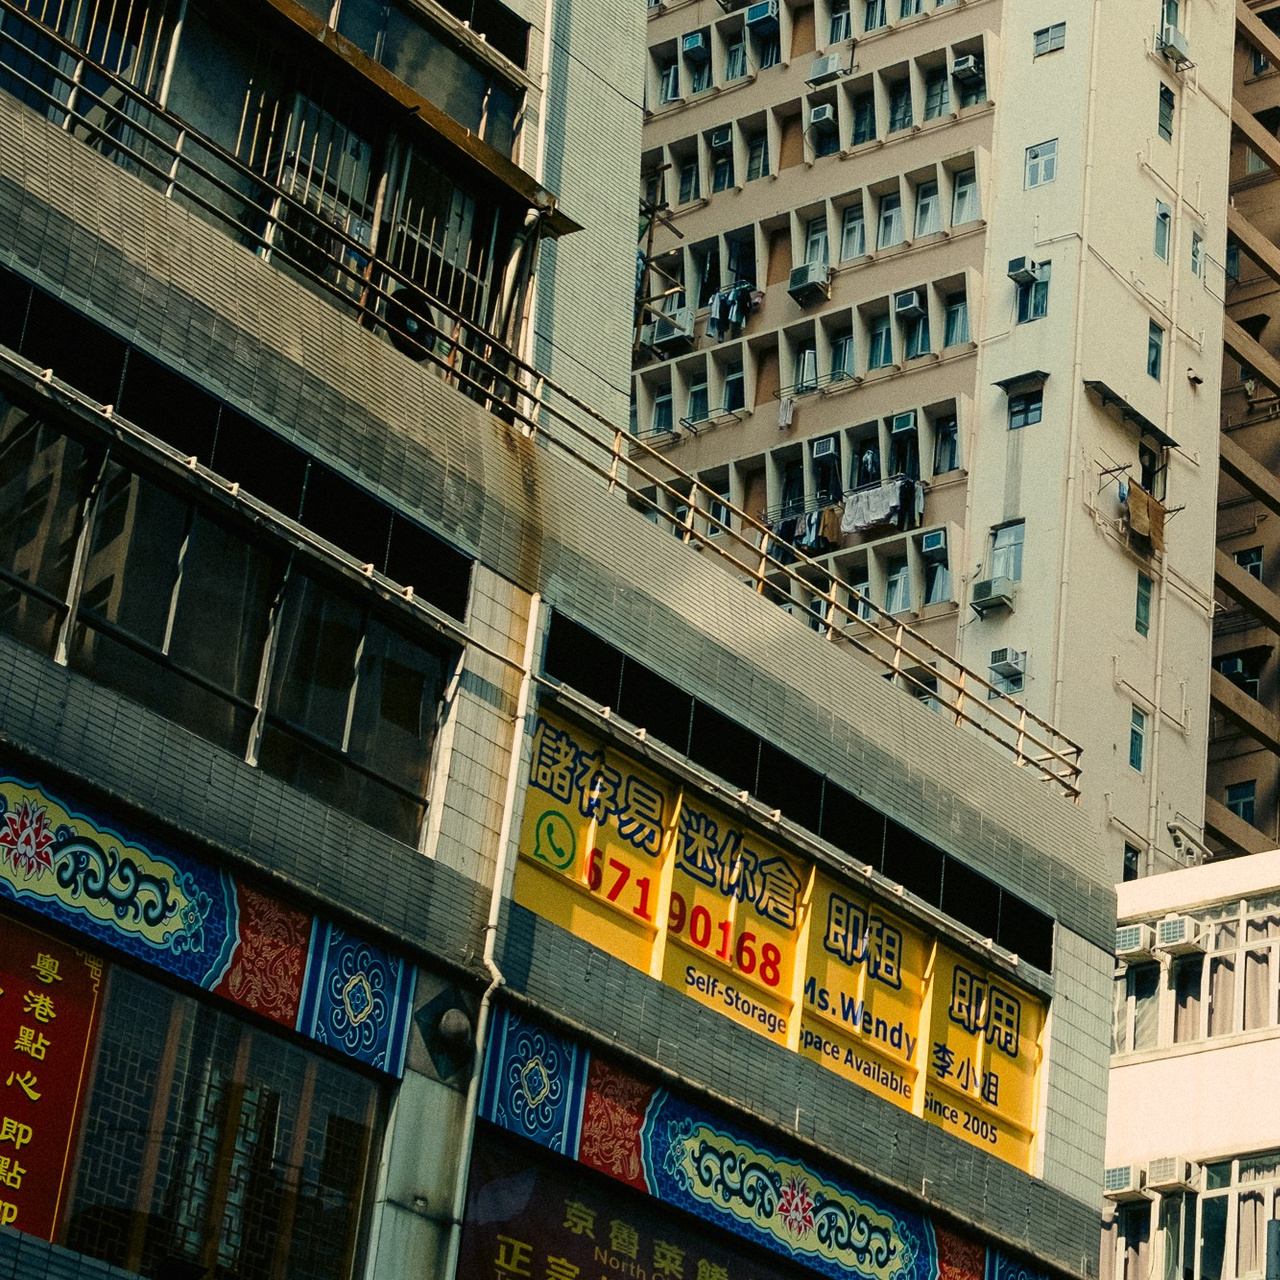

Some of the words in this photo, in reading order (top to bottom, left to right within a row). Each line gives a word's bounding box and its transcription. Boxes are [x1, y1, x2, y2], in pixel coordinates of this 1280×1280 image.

[686, 965, 786, 1033] Self-Storage
[824, 892, 902, 990] 即租
[949, 964, 1020, 1058] 即用
[844, 1049, 912, 1099] Available
[932, 1042, 998, 1107] 李小姐
[963, 1111, 998, 1144] 2005
